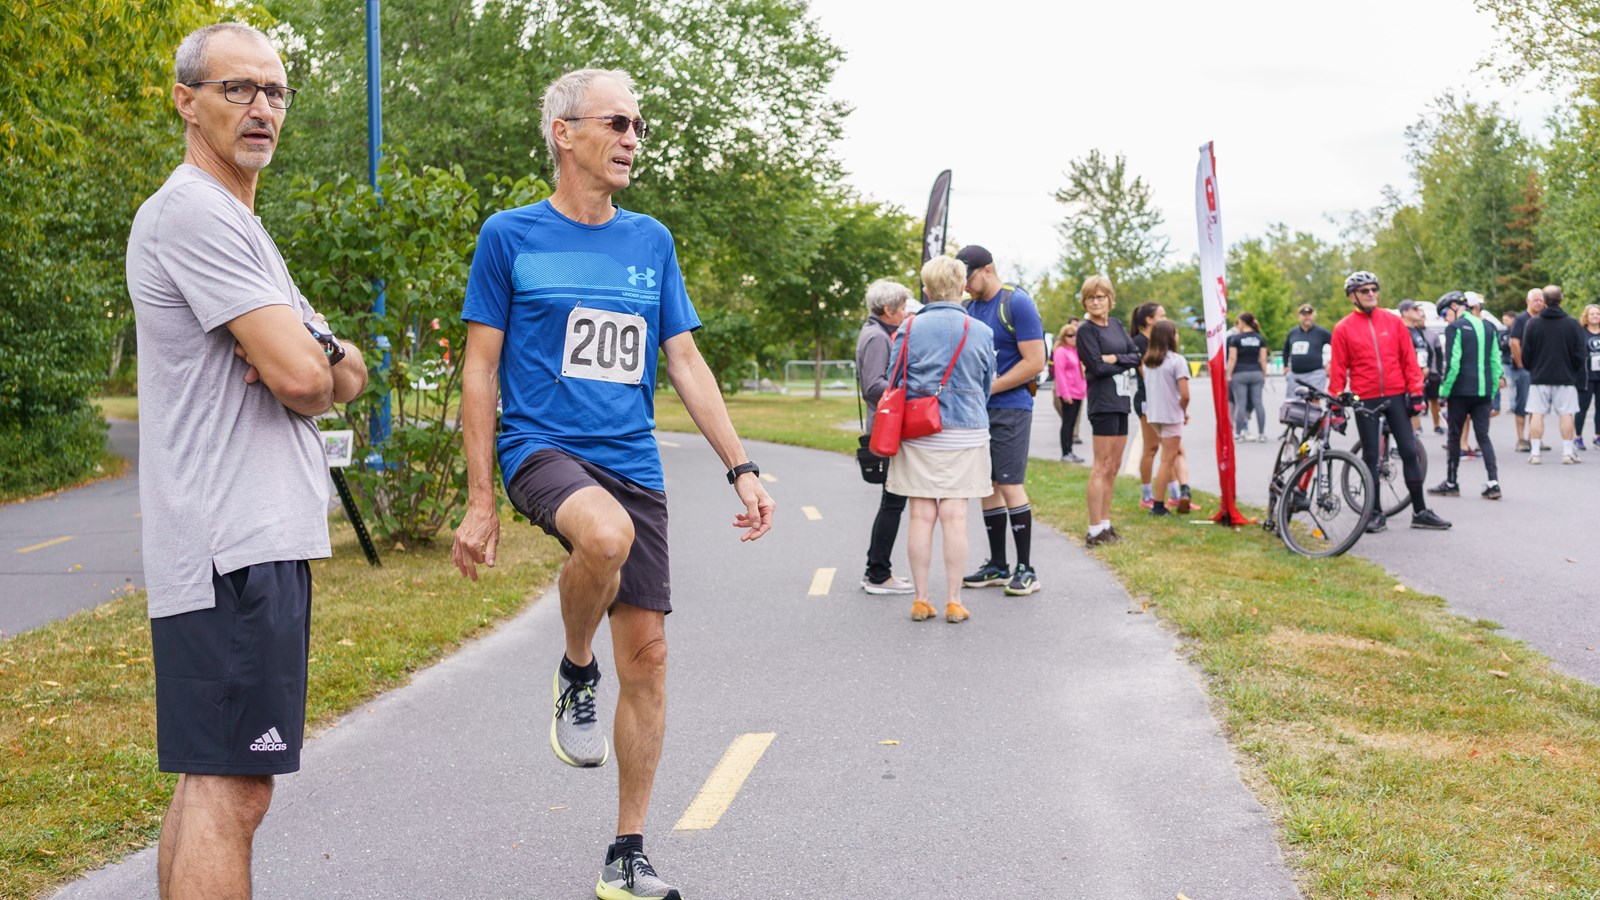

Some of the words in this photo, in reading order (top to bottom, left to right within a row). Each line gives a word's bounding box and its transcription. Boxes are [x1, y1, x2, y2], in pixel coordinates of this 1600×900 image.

[621, 291, 640, 299] UNDER
[570, 318, 640, 372] 209
[250, 742, 287, 751] adidas
